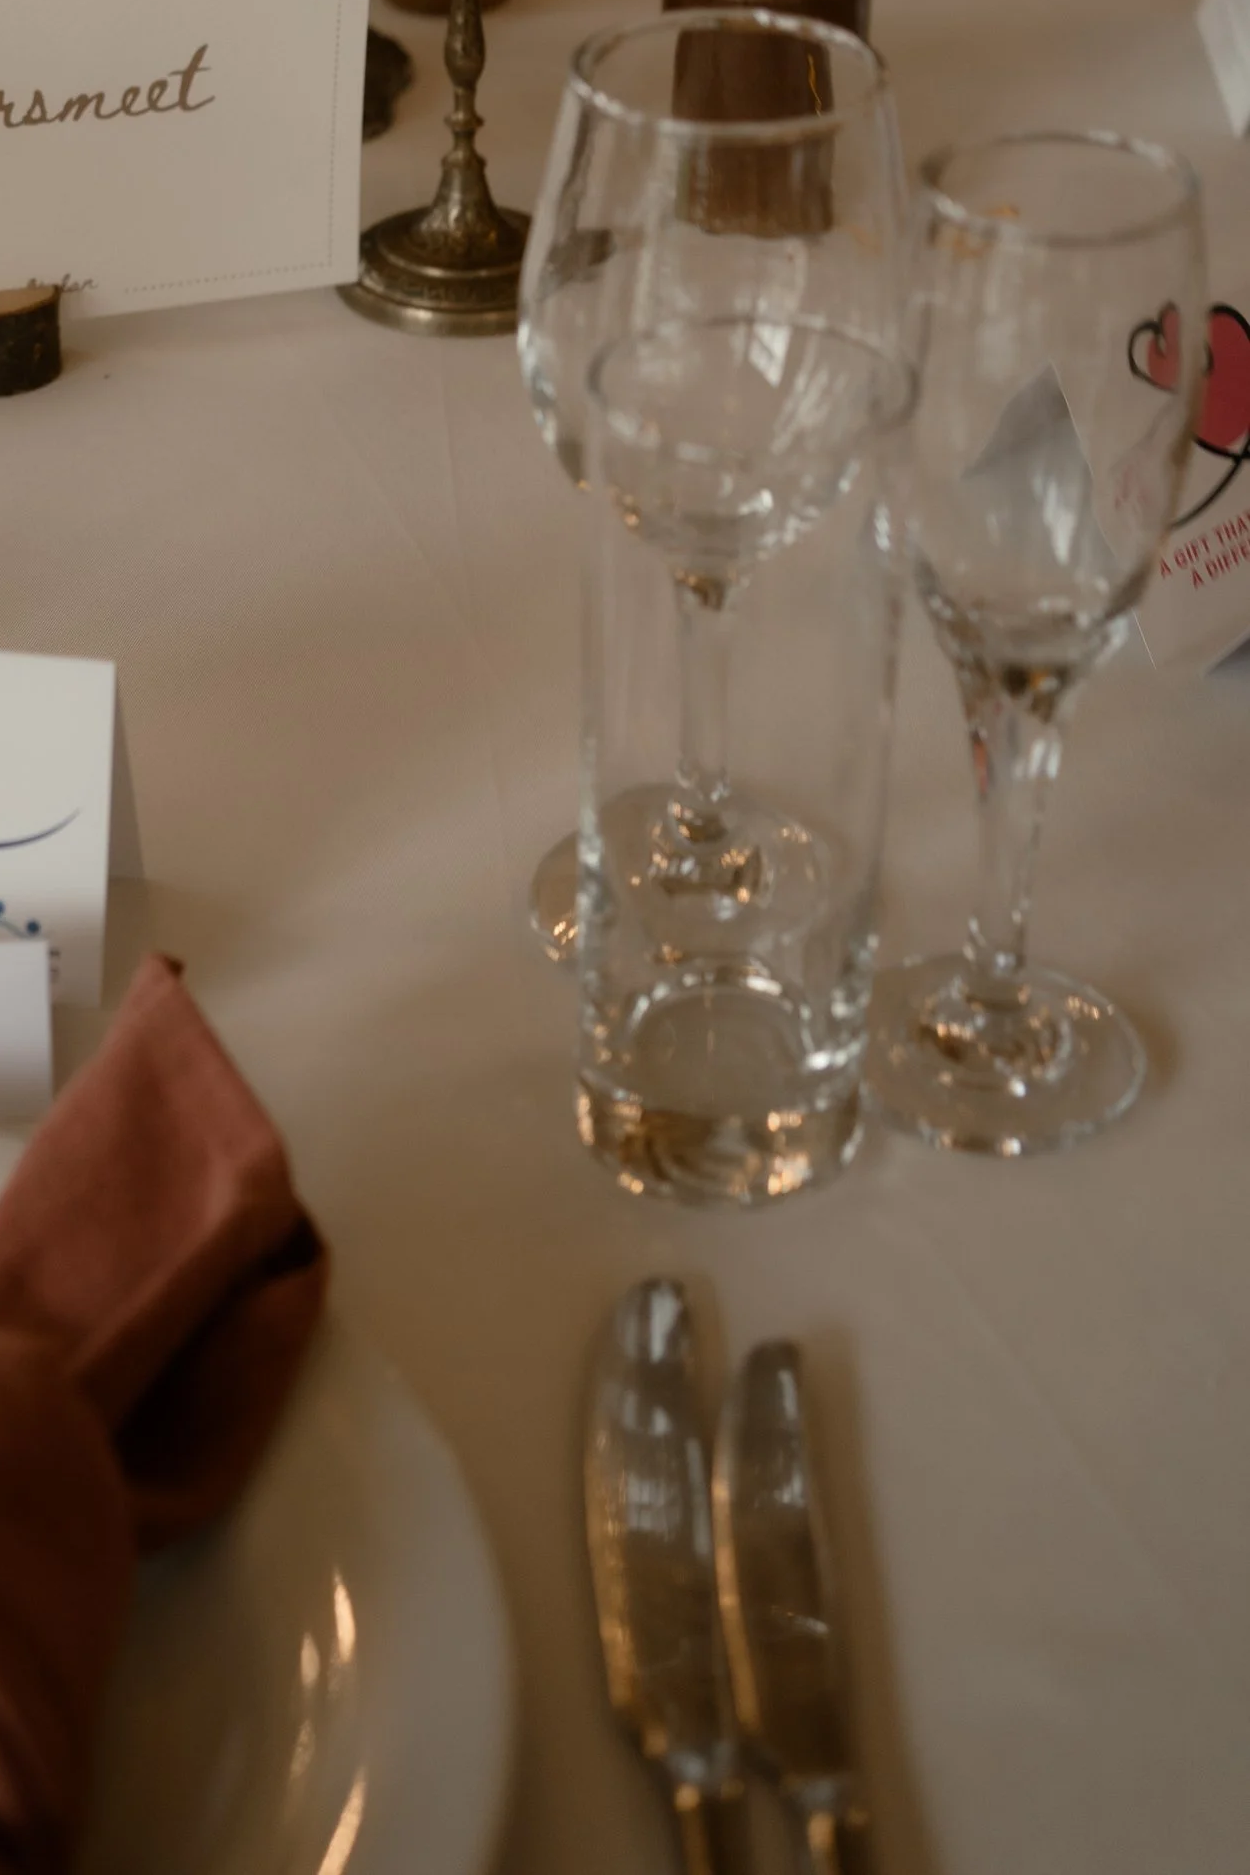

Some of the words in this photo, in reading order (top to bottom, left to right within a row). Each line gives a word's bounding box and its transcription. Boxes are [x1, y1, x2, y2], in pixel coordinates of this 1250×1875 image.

[1160, 556, 1173, 579] A
[1174, 533, 1210, 570] GIFT
[1192, 567, 1205, 591] A
